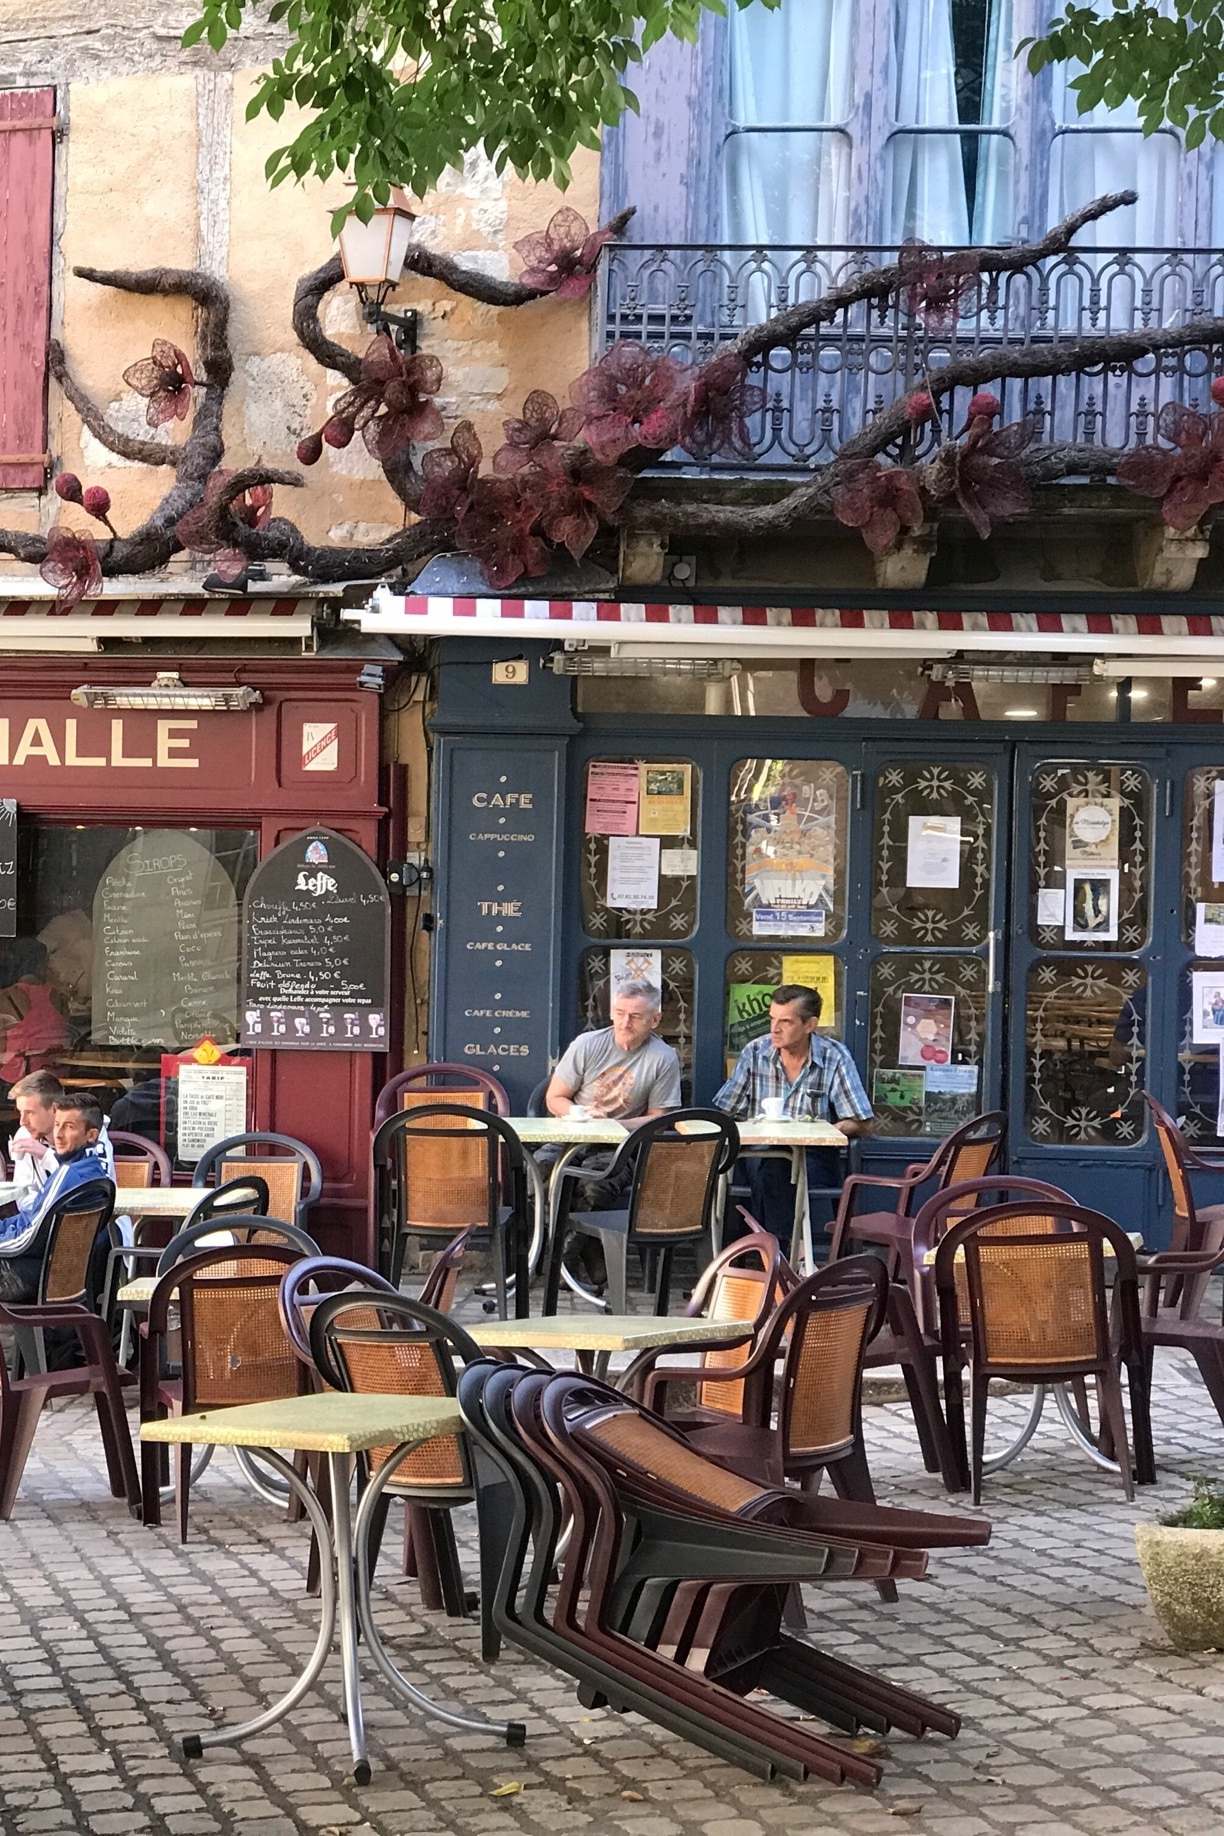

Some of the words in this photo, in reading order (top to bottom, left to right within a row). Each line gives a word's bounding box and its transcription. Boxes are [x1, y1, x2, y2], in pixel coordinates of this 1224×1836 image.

[505, 664, 516, 680] 9
[304, 728, 337, 765] LICENCE
[471, 792, 533, 809] CAFE
[469, 833, 535, 842] CAPPUCCINO
[295, 871, 338, 897] Leffe
[775, 911, 787, 921] 15
[179, 943, 201, 953] Coco
[466, 942, 495, 950] CAFE
[496, 942, 532, 951] GLACE
[464, 1009, 493, 1017] CAFE
[463, 1043, 530, 1056] GLACES
